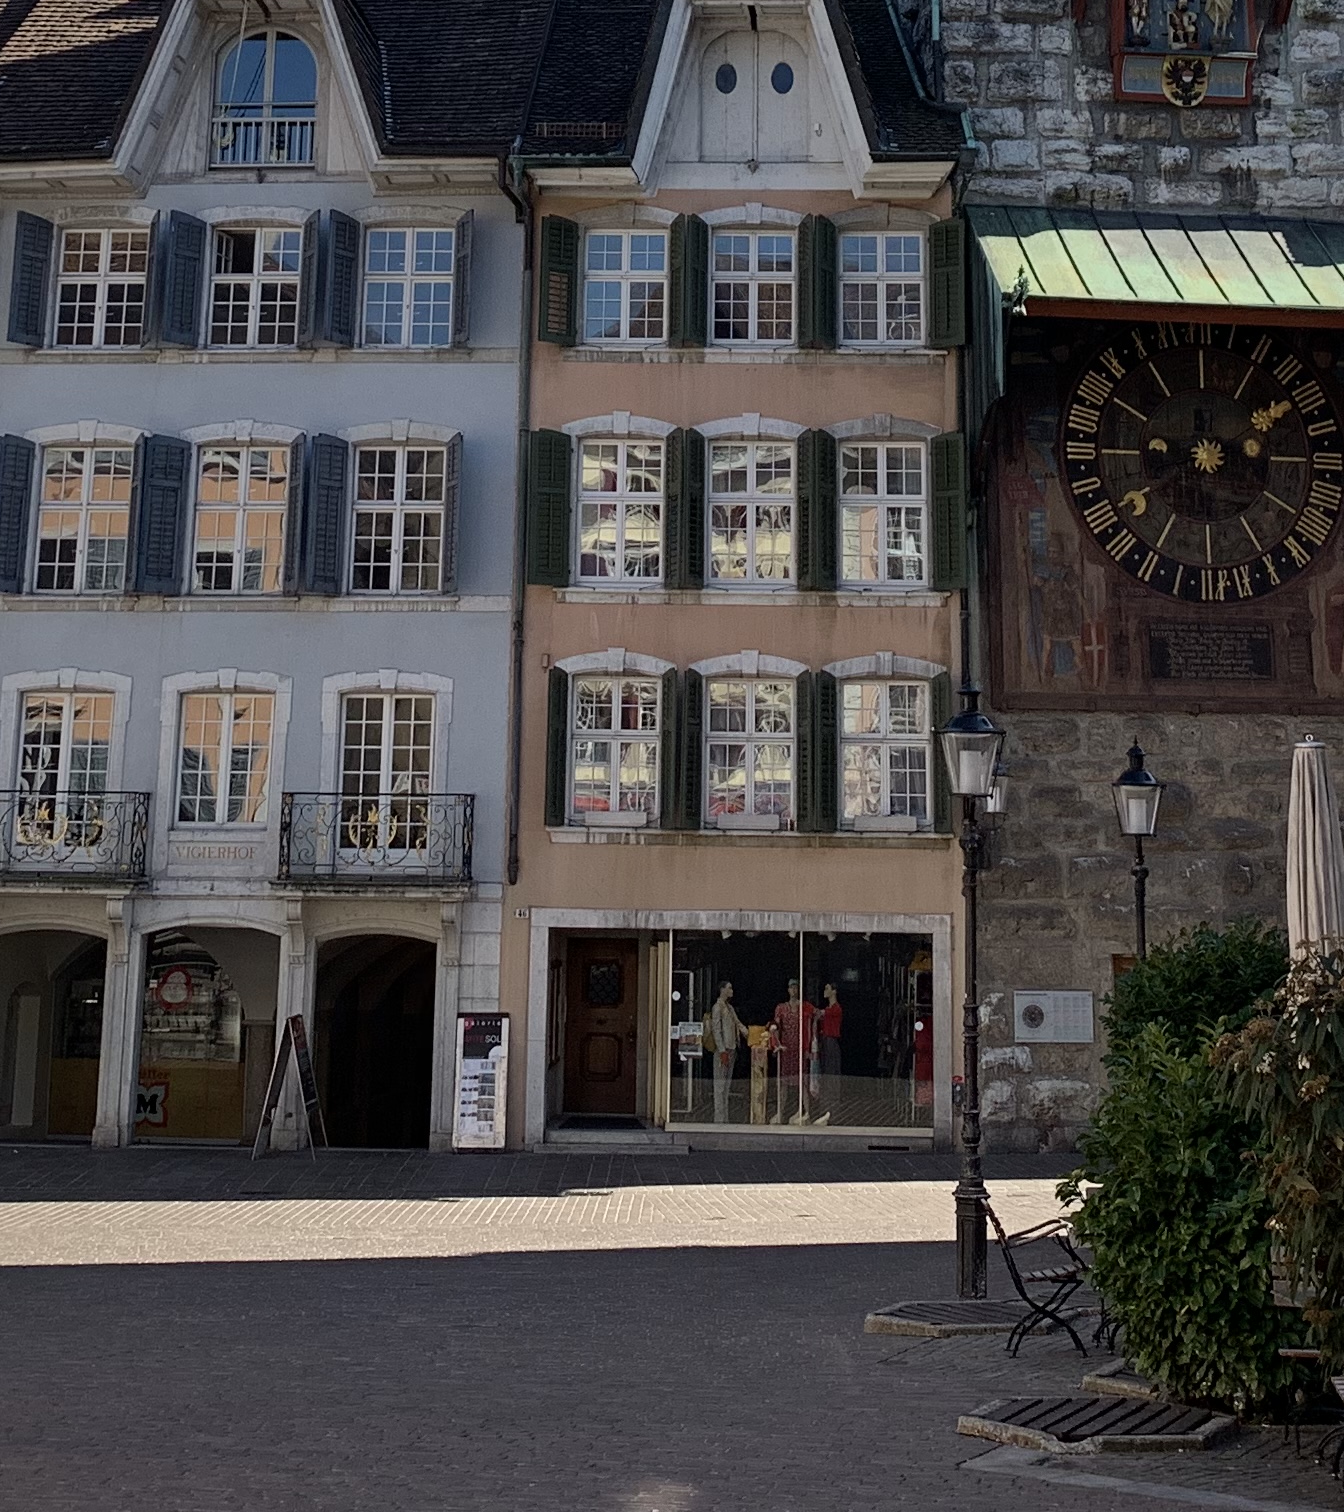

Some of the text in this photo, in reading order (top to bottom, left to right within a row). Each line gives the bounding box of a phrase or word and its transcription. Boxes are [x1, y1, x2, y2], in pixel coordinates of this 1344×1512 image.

[176, 846, 258, 859] VIGIERHOF
[518, 909, 527, 918] 46
[464, 1020, 501, 1028] galerie
[136, 1093, 158, 1115] M
